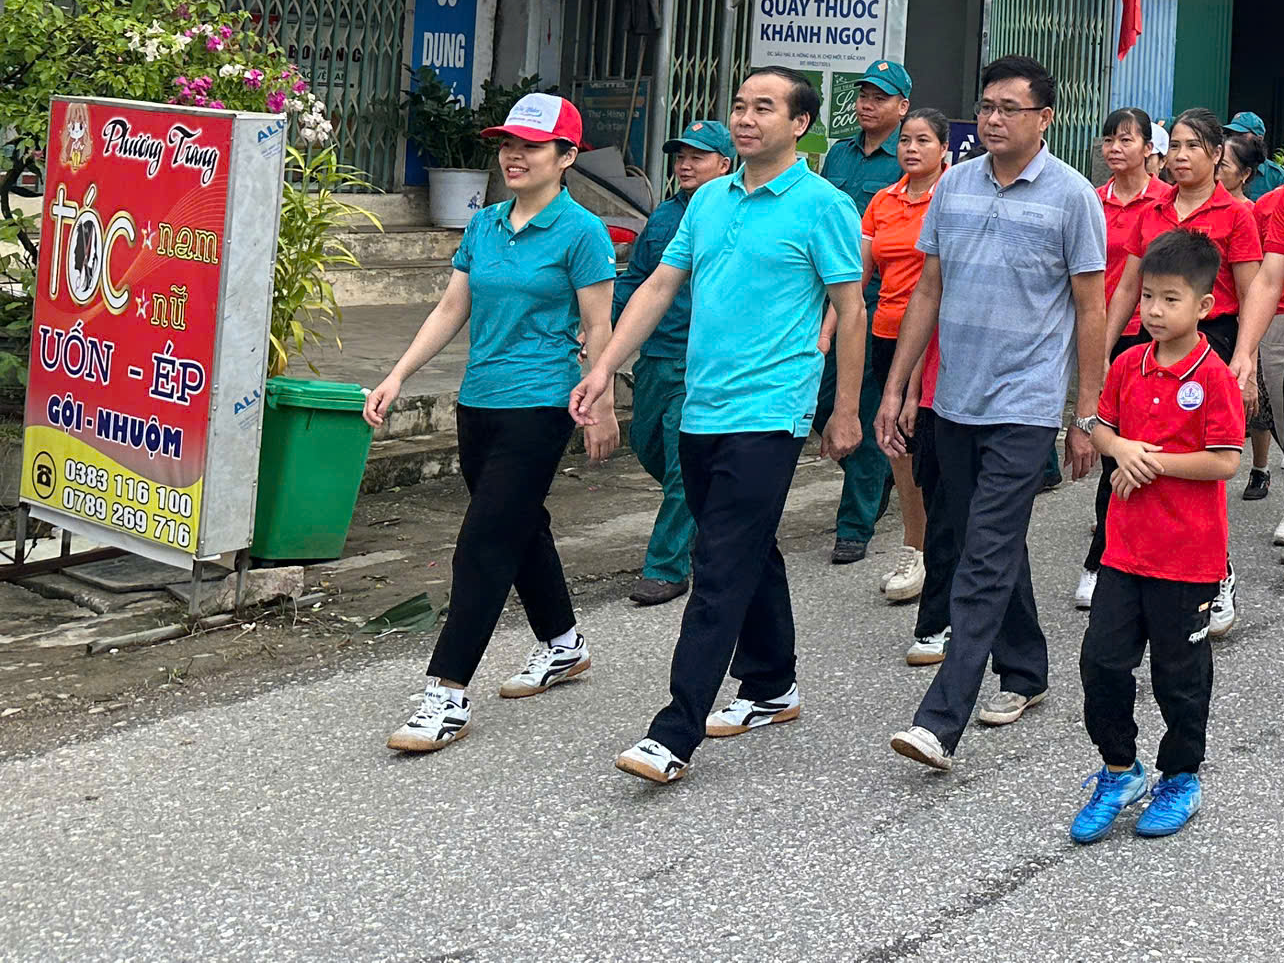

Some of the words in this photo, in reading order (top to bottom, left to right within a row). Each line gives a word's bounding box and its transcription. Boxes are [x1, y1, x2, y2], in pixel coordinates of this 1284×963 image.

[422, 31, 466, 76] DỤNG
[760, 21, 821, 44] KHÁNH
[825, 27, 877, 51] NGỌC
[102, 118, 166, 179] Phương
[168, 125, 220, 186] Trang
[156, 218, 219, 266] nam
[150, 284, 188, 330] nữ
[38, 321, 114, 385] UỐN
[150, 341, 205, 405] ÉP
[47, 394, 83, 433] GỘI
[96, 413, 184, 461] NHUỘM
[62, 487, 107, 523] 0789
[112, 499, 148, 534] 269
[153, 512, 191, 548] 716
[65, 458, 109, 492] 0383
[114, 471, 150, 506] 116
[156, 483, 192, 519] 100
